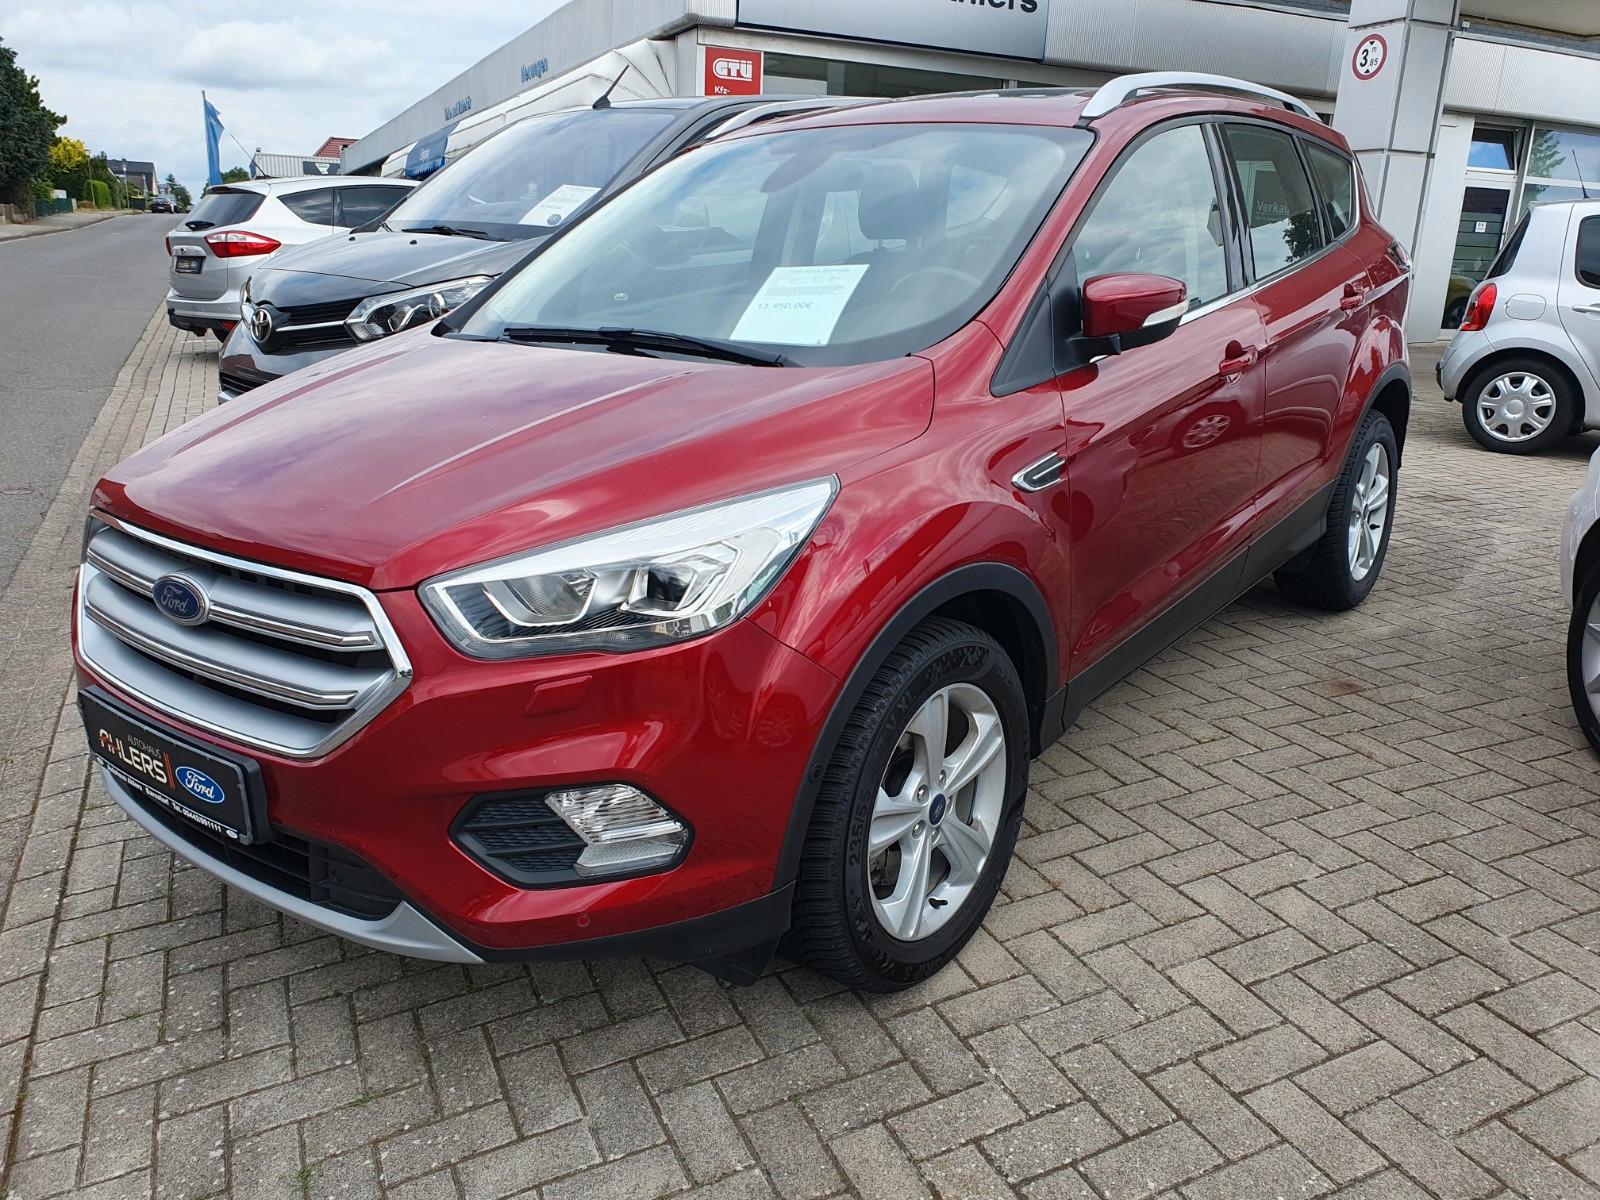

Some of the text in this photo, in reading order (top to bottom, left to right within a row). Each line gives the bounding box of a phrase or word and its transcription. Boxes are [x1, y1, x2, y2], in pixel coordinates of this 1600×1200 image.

[714, 85, 731, 94] Kfz-
[161, 585, 189, 613] Ford
[99, 728, 167, 784] AHLERS
[127, 733, 162, 759] AUTOHAUS
[185, 770, 215, 799] Ford
